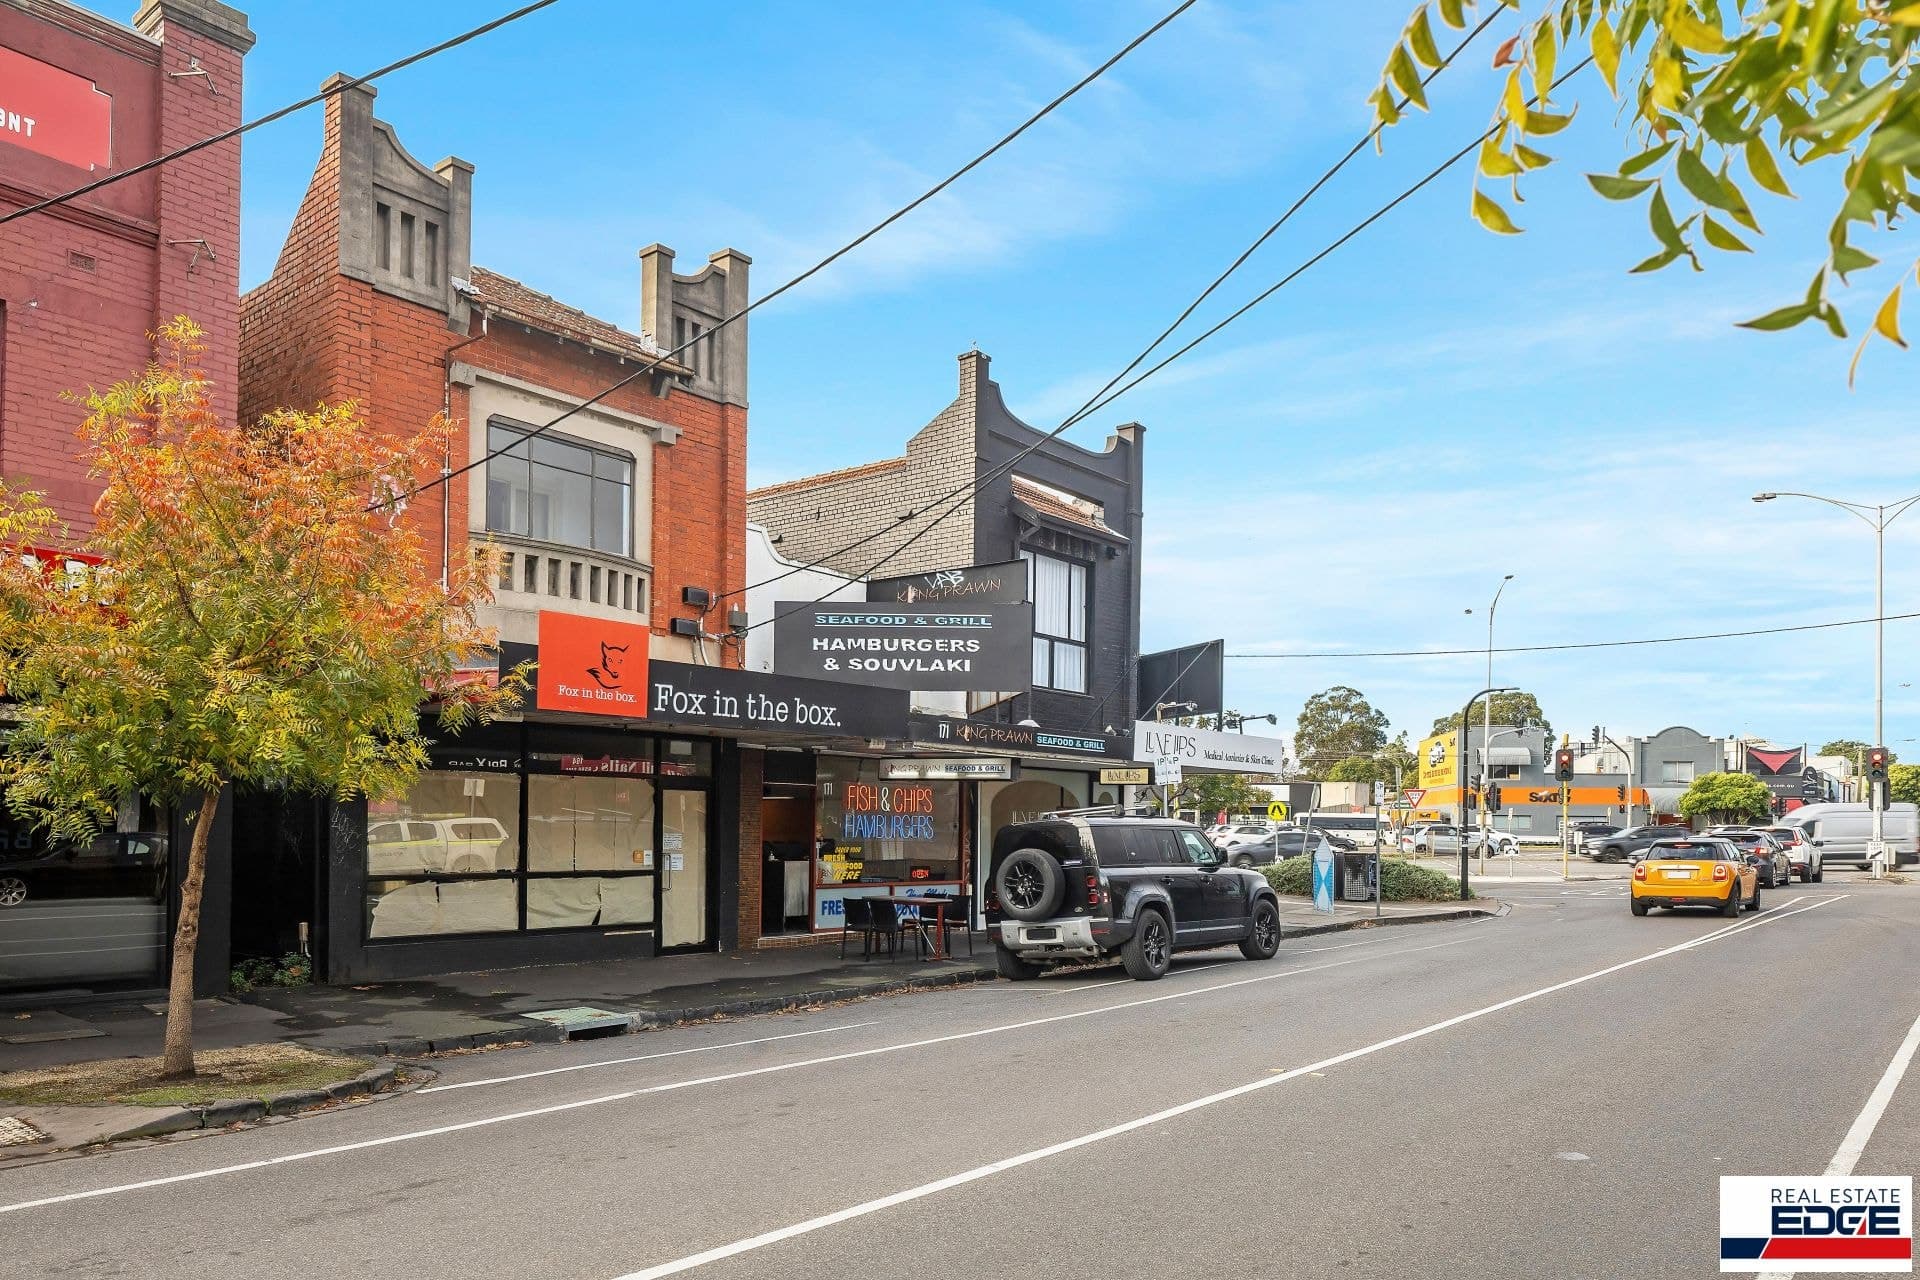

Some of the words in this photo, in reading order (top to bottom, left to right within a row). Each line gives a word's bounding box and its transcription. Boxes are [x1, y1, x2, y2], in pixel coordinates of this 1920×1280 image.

[943, 578, 1001, 597] PRAWN
[816, 615, 907, 625] SEAFOOD
[913, 616, 928, 625] &
[934, 617, 993, 626] GRILL
[812, 637, 981, 653] HAMBURGERS
[823, 657, 841, 671] &
[848, 658, 972, 673] SOUVLAKI
[558, 685, 580, 697] Fox
[581, 687, 594, 699] in
[595, 688, 614, 700] the
[615, 690, 638, 703] box.
[654, 683, 707, 715] Fox
[712, 689, 741, 718] in
[746, 693, 790, 723] the
[794, 697, 842, 728] box.
[989, 728, 1034, 745] PRAWN
[1036, 736, 1074, 747] SEAFOOD
[1075, 739, 1083, 748] &
[1083, 740, 1106, 750] GRILL
[944, 765, 976, 773] SEAFOOD
[847, 785, 878, 811] FISH
[881, 787, 891, 811] &
[893, 788, 933, 813] CHIPS
[844, 814, 935, 839] HAMBURGERS
[833, 871, 861, 880] HERE
[911, 868, 929, 878] OPEN
[821, 900, 846, 915] FRE
